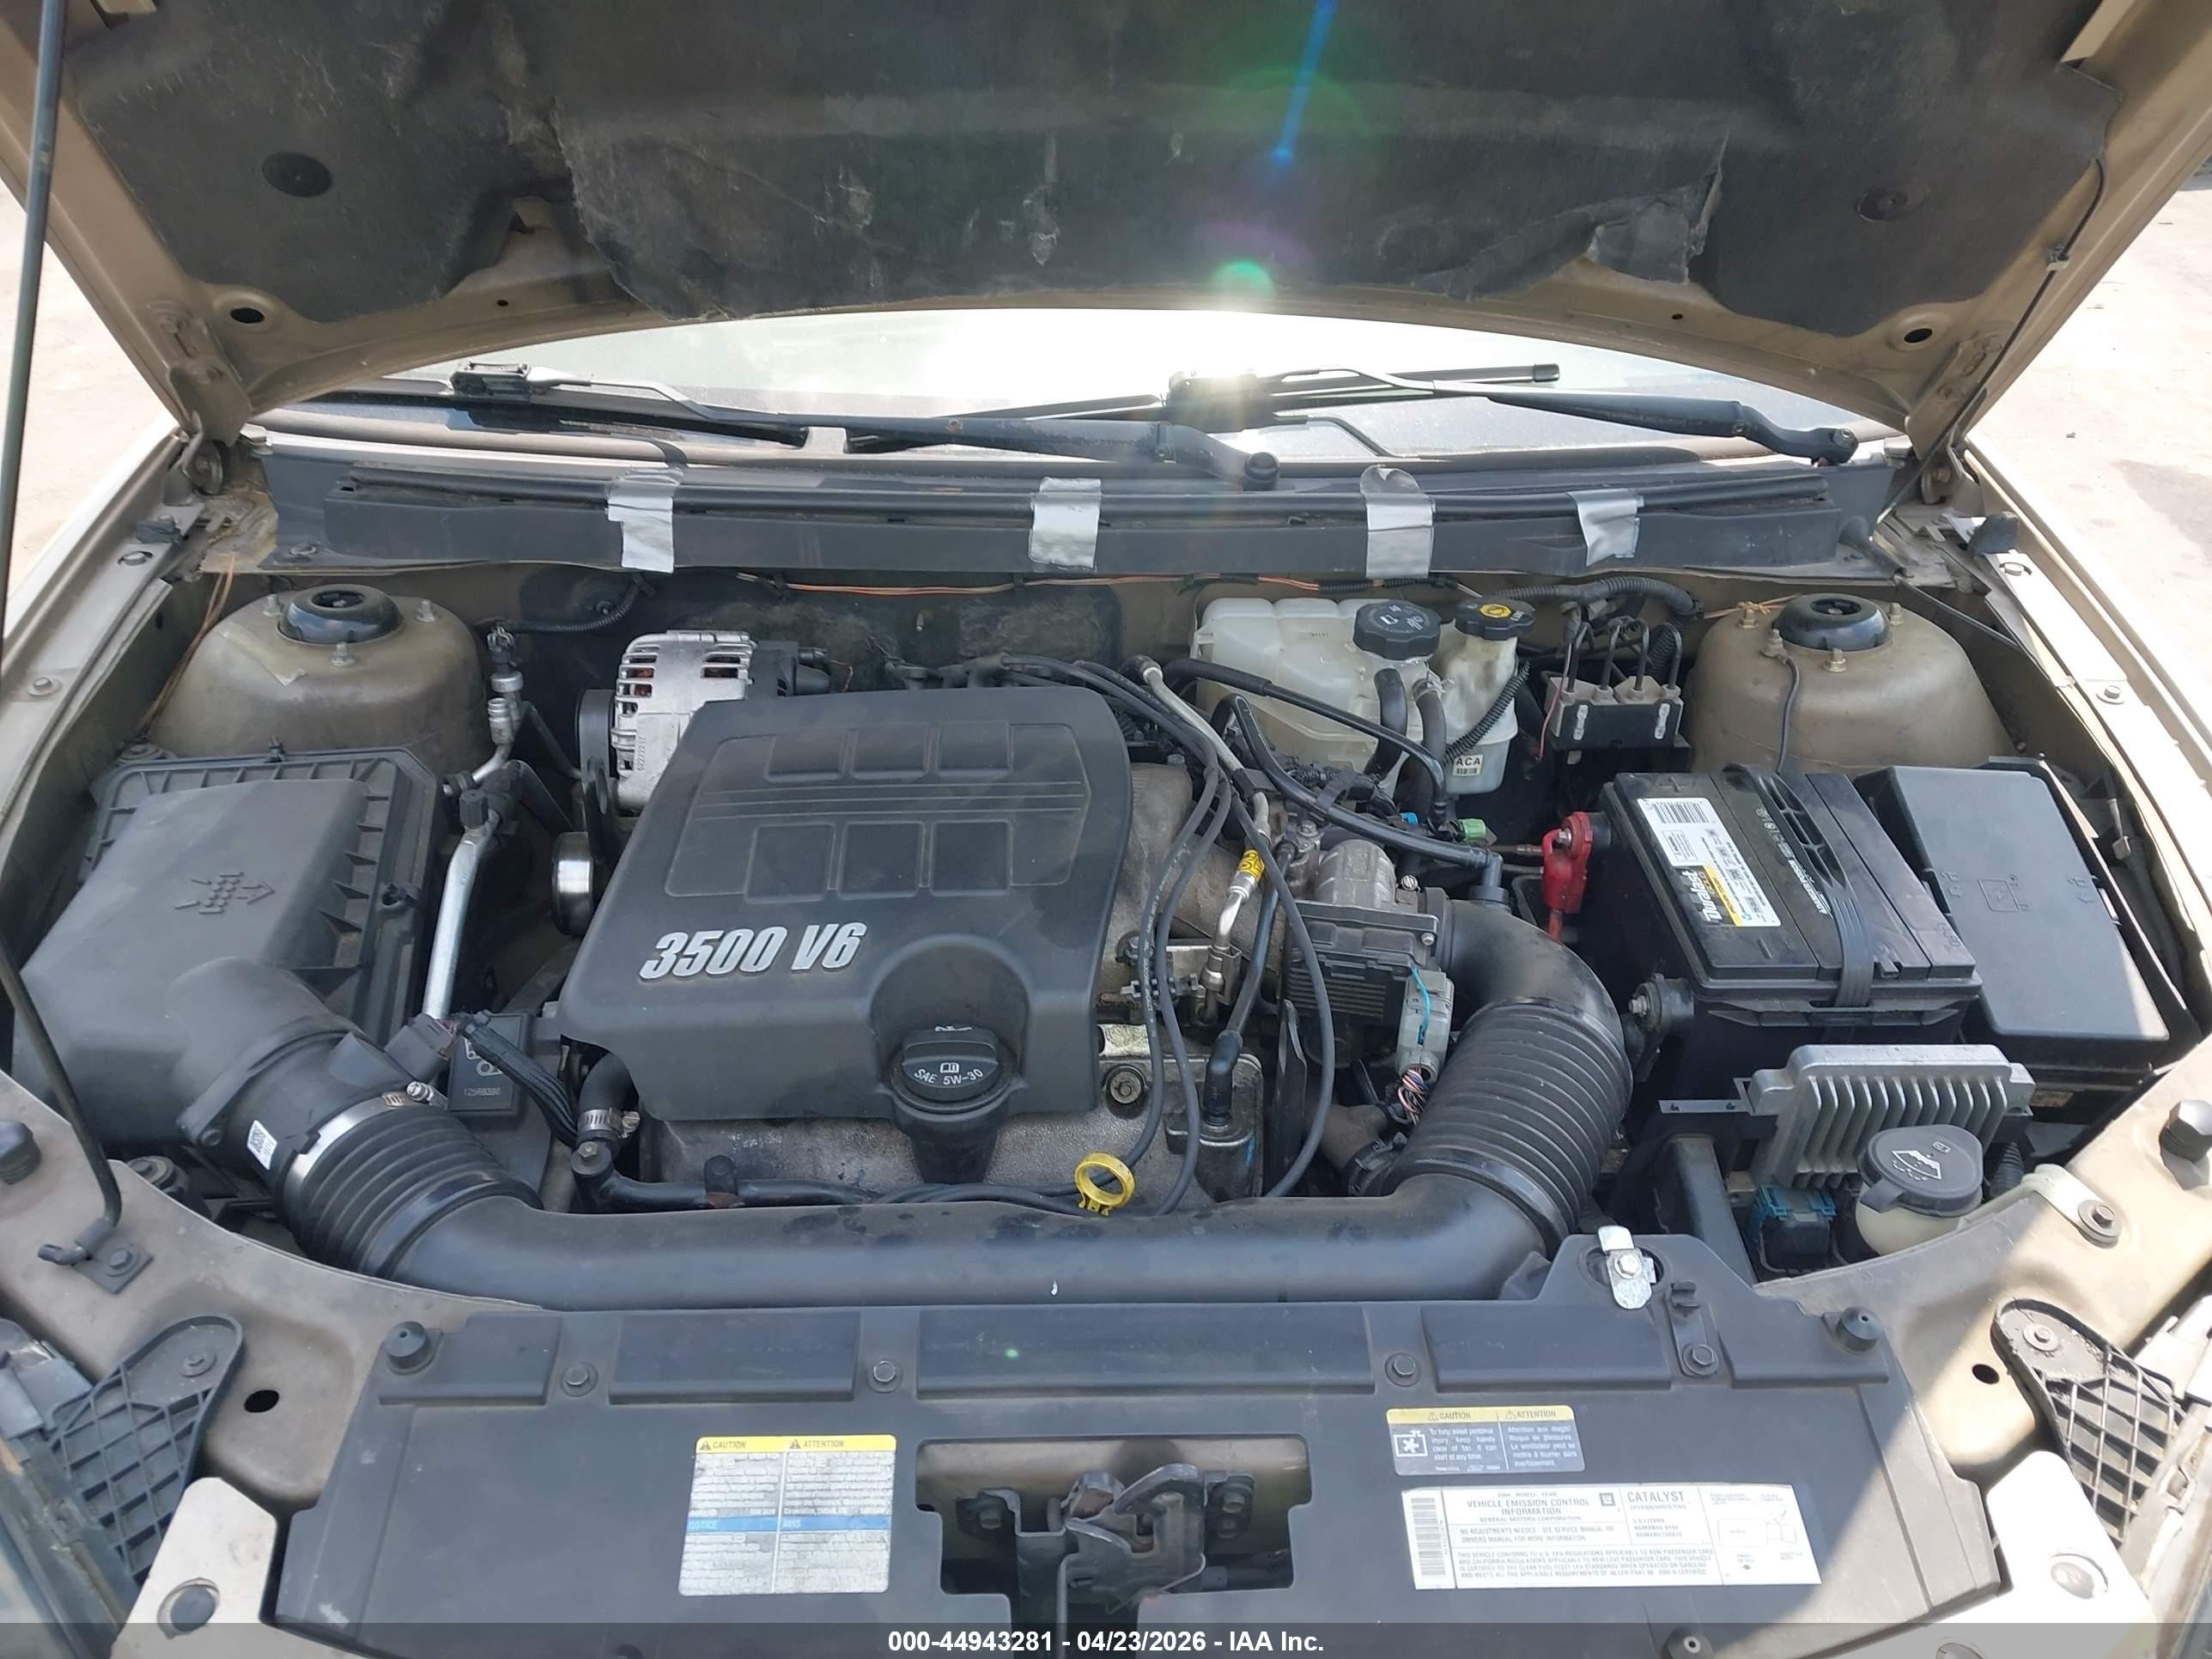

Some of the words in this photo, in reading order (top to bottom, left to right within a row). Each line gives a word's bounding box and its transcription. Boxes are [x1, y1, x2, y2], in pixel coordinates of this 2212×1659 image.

[1681, 870, 1723, 921] Duralast
[639, 926, 788, 980] 3500
[791, 921, 868, 971] V6
[914, 1068, 938, 1084] SAE
[943, 1068, 983, 1085] 5W-30
[713, 1441, 746, 1449] CAUTION
[1628, 1491, 1684, 1502] CATALYST
[1467, 1499, 1503, 1508] VEHICLE
[1502, 1507, 1561, 1516] INFORMATION
